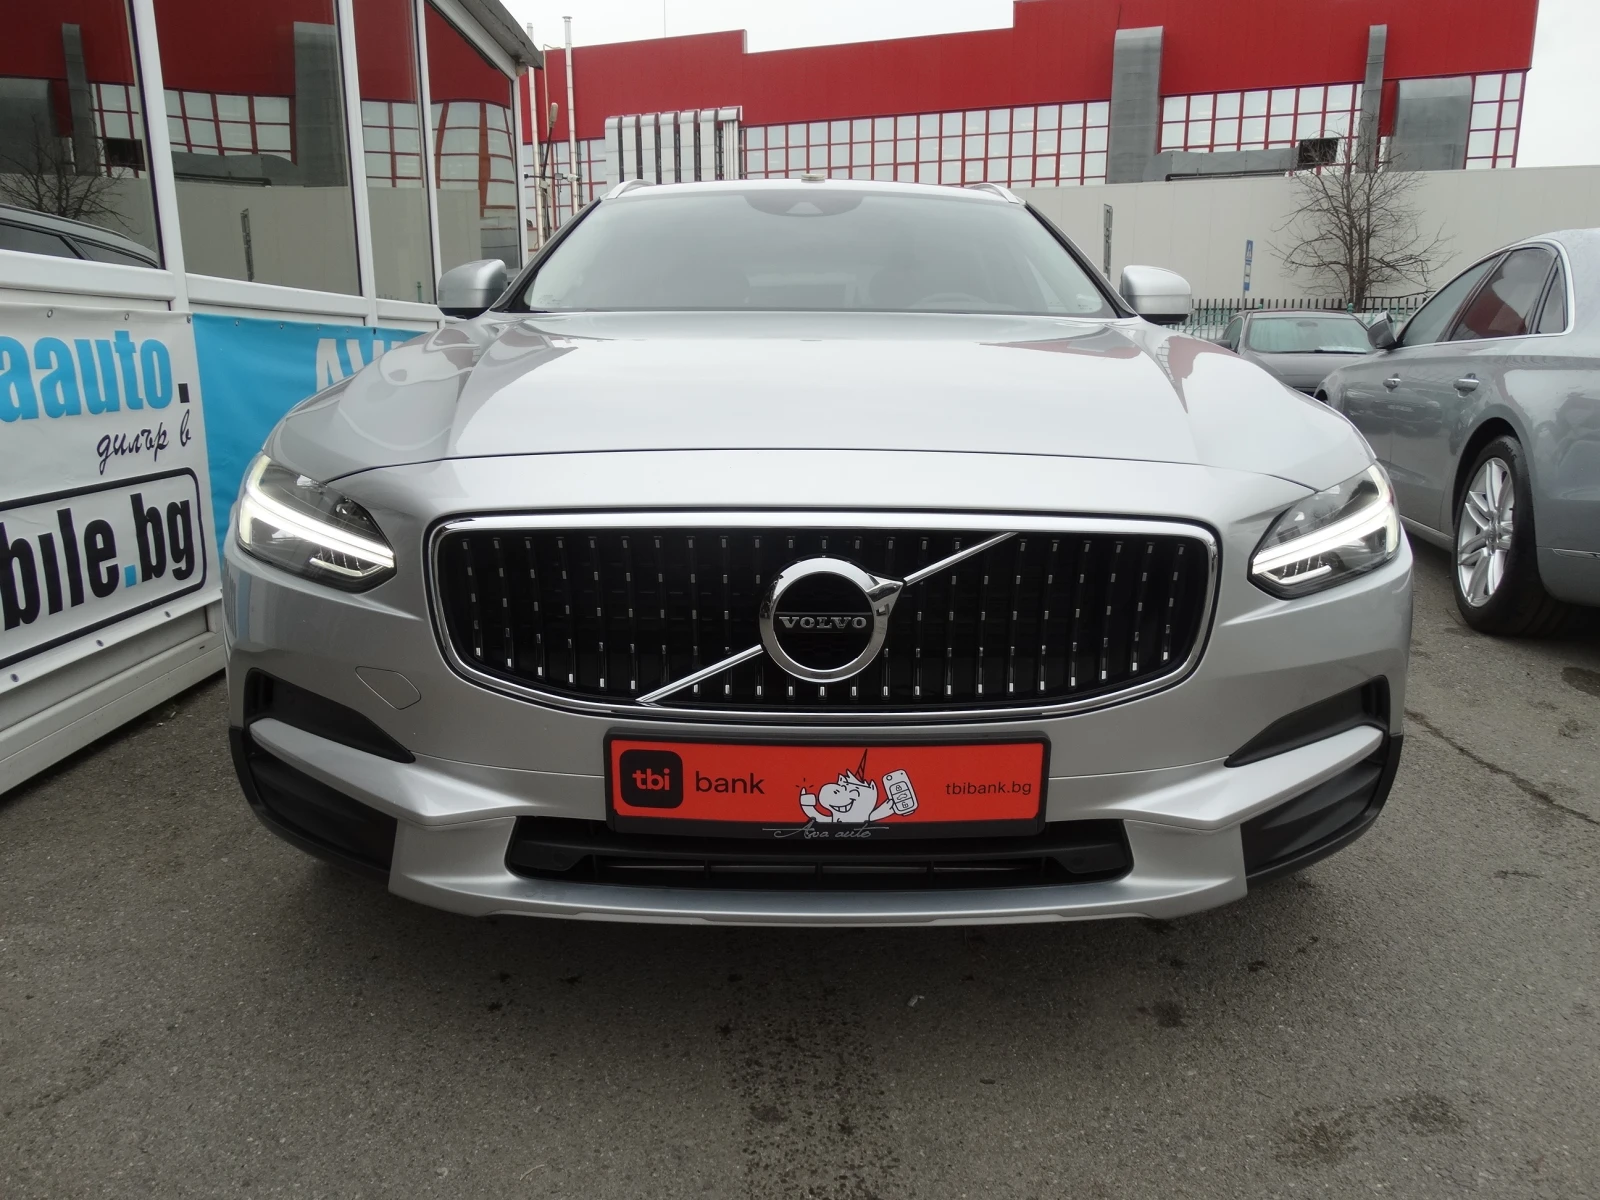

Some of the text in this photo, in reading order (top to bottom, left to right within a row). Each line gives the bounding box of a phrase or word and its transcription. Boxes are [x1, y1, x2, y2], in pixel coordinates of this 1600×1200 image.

[97, 422, 169, 475] дилър
[779, 616, 867, 629] VOLVO
[632, 768, 765, 795] tbi bank
[945, 781, 1032, 796] tbibank.bg
[835, 823, 889, 838] auto
